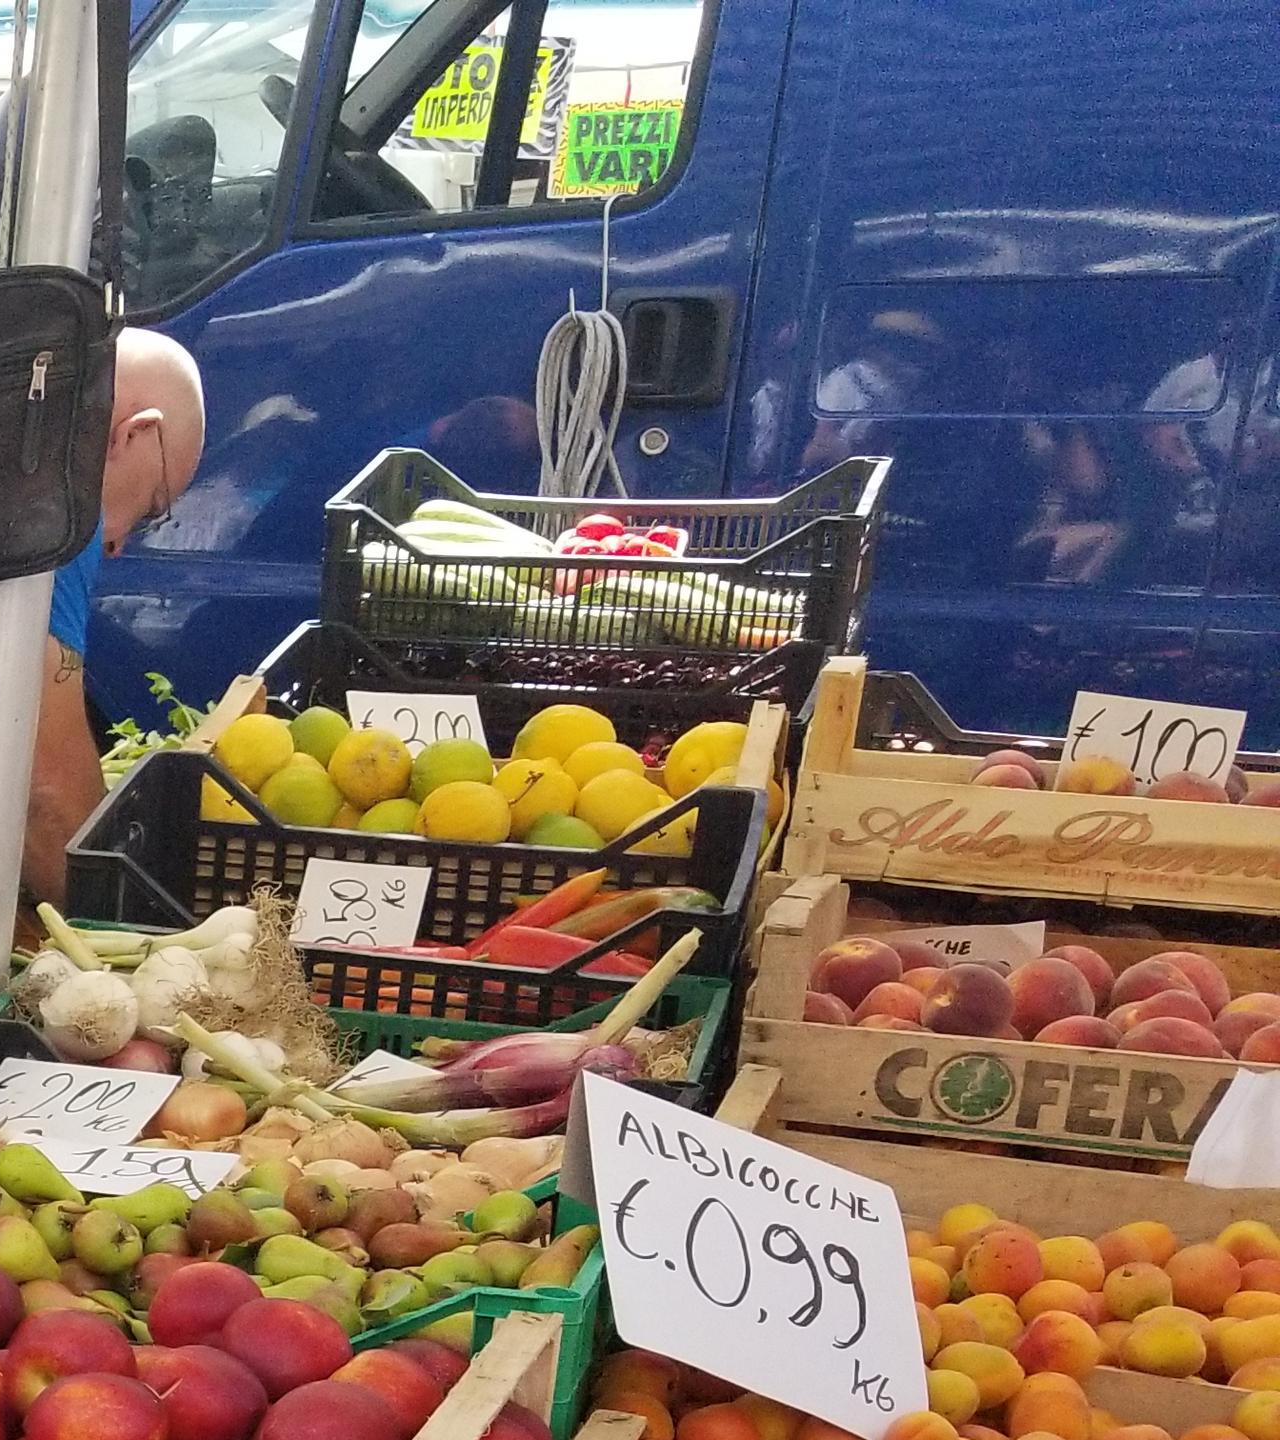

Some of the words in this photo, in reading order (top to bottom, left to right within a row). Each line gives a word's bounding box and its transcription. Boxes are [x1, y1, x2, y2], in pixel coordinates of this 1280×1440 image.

[576, 110, 673, 147] PREZZI
[572, 146, 672, 186] VARI
[618, 1110, 880, 1223] ALBICOCCHE
